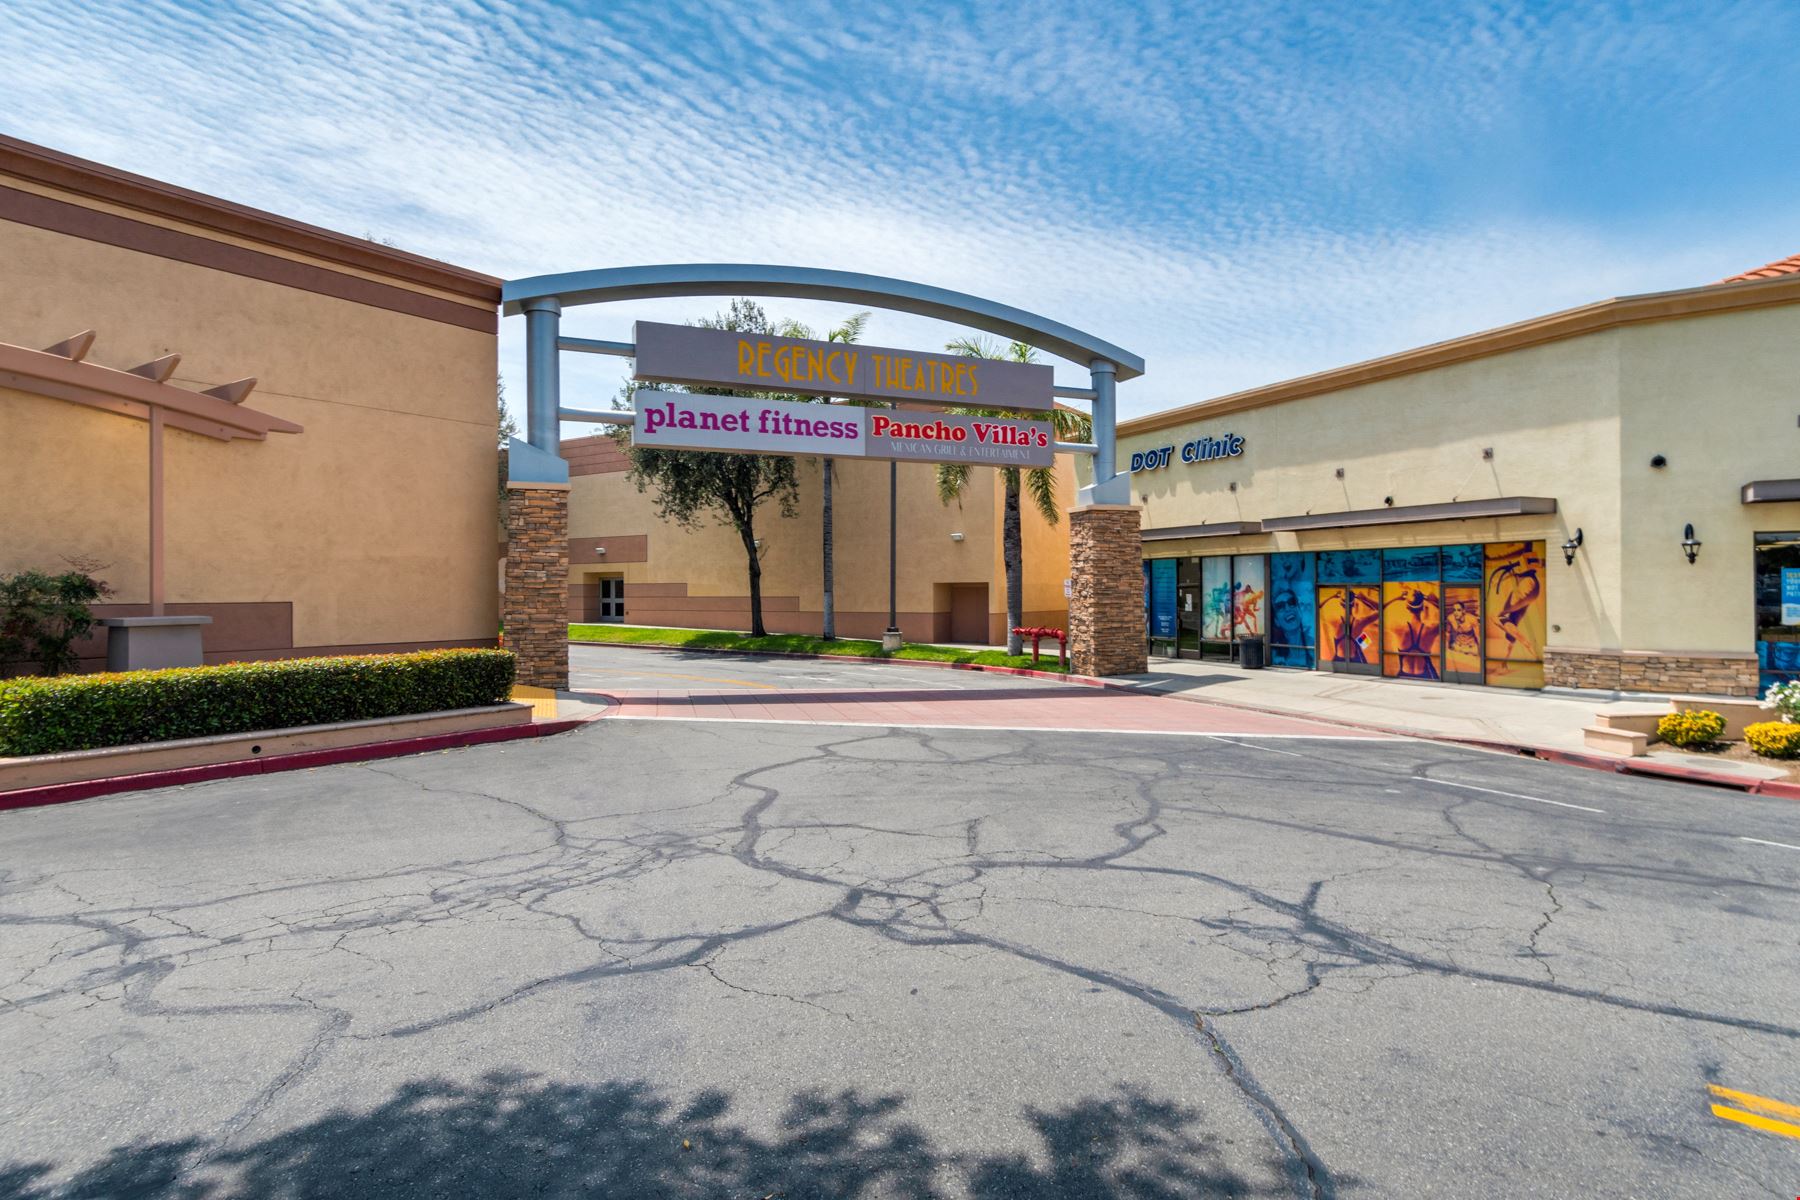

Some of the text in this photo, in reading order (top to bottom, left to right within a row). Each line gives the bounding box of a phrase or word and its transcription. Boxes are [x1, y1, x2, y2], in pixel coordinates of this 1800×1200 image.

[737, 339, 978, 396] REGENCY THEATRES
[644, 402, 859, 440] planet fitness
[871, 415, 1048, 447] Pancho Villa's
[890, 441, 932, 454] MEXICAN
[1130, 433, 1245, 473] DOT Clinic
